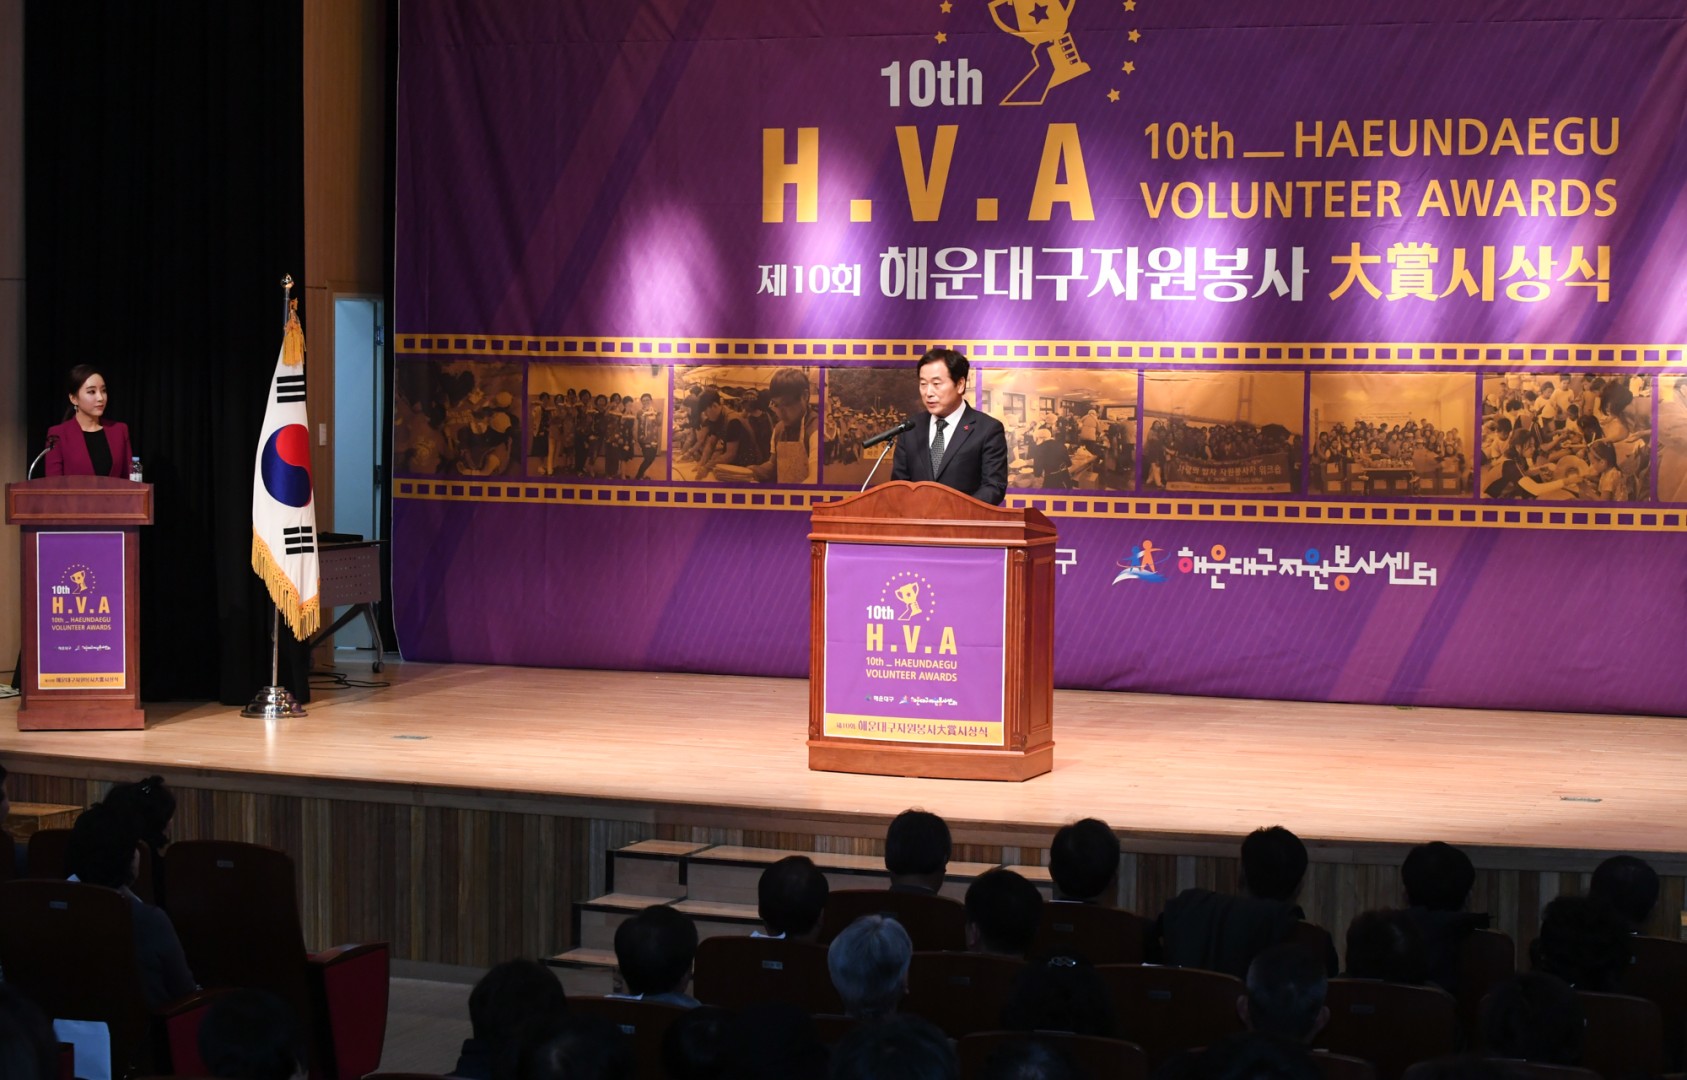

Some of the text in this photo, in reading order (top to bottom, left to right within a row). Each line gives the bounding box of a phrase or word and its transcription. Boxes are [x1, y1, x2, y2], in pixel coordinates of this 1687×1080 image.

[880, 58, 983, 107] 10th
[1140, 178, 1618, 219] VOLUNTEER AWARDS
[756, 242, 1611, 303] 제10회 해운대구자원봉사 大賞시상식
[1177, 545, 1437, 591] 해운대구자원봉사센터
[52, 585, 70, 595] 10th
[866, 605, 894, 620] 10th
[866, 656, 884, 666] 10th
[894, 658, 957, 670] HAEUNDAEGU
[866, 669, 958, 682] VOLUNTEER AWARDS
